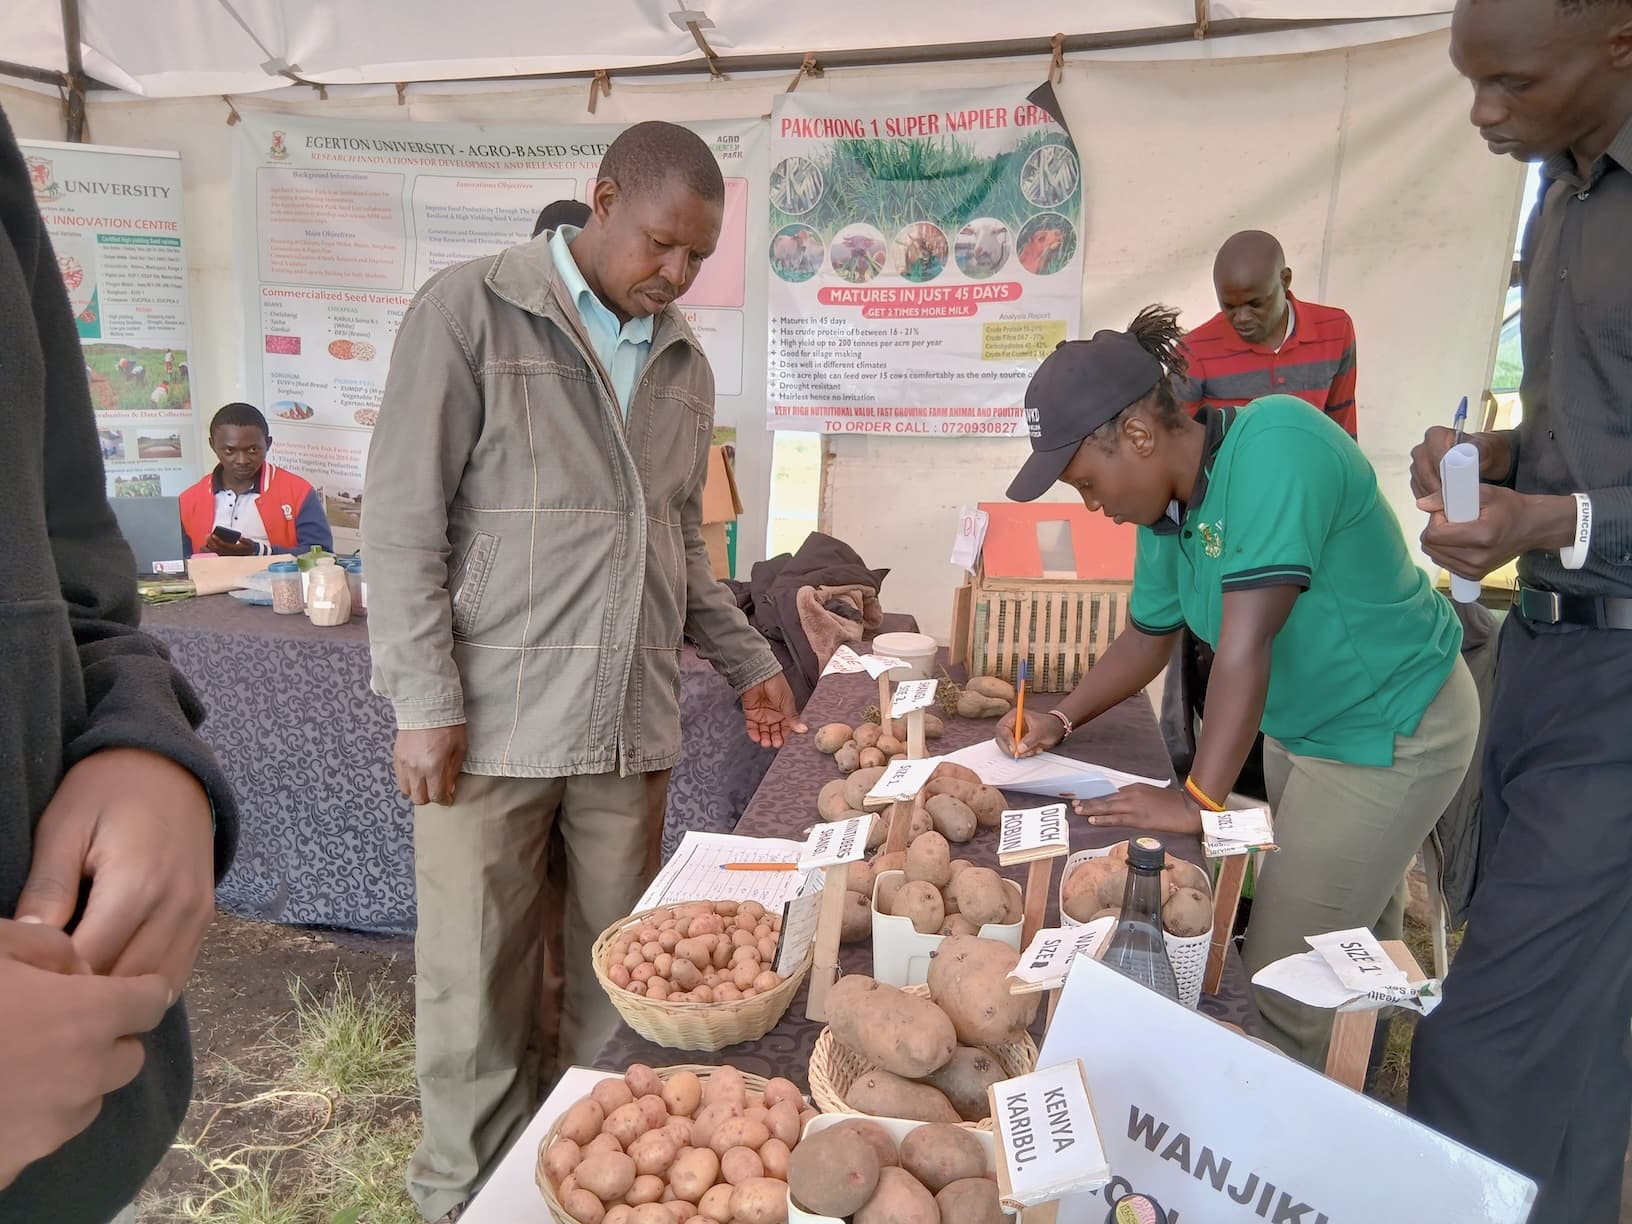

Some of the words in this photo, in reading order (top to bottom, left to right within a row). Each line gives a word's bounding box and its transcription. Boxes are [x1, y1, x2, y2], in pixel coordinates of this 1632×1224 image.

[781, 118, 865, 138] PAKCHONG
[870, 119, 879, 138] 1
[885, 114, 940, 137] SUPER
[945, 107, 1008, 132] NAPIER
[717, 135, 740, 144] AGRO
[305, 136, 371, 151] EGERTON
[373, 139, 455, 156] UNIVERSITY
[468, 144, 567, 158] AGRO-BASED
[311, 152, 355, 162] RESEARCH
[357, 154, 418, 165] INNOVATIONS
[420, 158, 438, 167] FOR
[439, 159, 500, 169] DEVELOPMENT
[504, 161, 523, 169] AND
[526, 161, 562, 169] RELEASE
[565, 161, 576, 169] OF
[722, 151, 743, 160] PARK
[64, 180, 170, 199] UNIVERSITY
[53, 215, 132, 229] INNOVATION
[134, 218, 178, 231] CENTRE
[262, 286, 344, 302] Commercialized
[344, 293, 368, 303] Seed
[830, 288, 897, 303] MATURES
[901, 288, 915, 301] IN
[917, 287, 952, 305] JUST
[955, 287, 970, 300] 45
[972, 285, 1009, 299] DAYS
[868, 308, 885, 317] GET
[894, 307, 919, 317] TIMES
[921, 307, 946, 317] MORE
[948, 306, 970, 316] MILK
[780, 316, 808, 325] Matures
[810, 316, 818, 325] in
[820, 317, 828, 325] 45
[830, 316, 846, 327] days
[780, 328, 794, 336] Has
[795, 328, 816, 336] crude
[817, 328, 845, 338] protein
[846, 328, 854, 336] of
[855, 328, 888, 336] between
[890, 328, 898, 336] 16
[904, 327, 920, 336] 21%
[780, 338, 797, 348] High
[798, 338, 815, 348] yield
[816, 340, 826, 349] up
[828, 339, 837, 347] to
[838, 339, 852, 347] 200
[853, 339, 879, 347] tonnes
[880, 340, 892, 349] per
[911, 340, 924, 349] per
[926, 339, 944, 349] year
[780, 349, 800, 358] Good
[800, 349, 811, 358] for
[813, 349, 833, 359] silage
[834, 350, 862, 360] making
[779, 360, 798, 369] Does
[799, 360, 813, 369] well
[814, 361, 822, 369] in
[823, 360, 855, 369] different
[856, 361, 887, 369] climates
[779, 371, 796, 379] One
[844, 371, 860, 380] feed
[879, 372, 888, 380] 15
[909, 371, 955, 381] comfortably
[966, 371, 979, 379] the
[980, 371, 998, 381] only
[779, 381, 810, 391] Drought
[810, 382, 841, 391] resistant
[810, 392, 831, 401] hence
[842, 392, 876, 401] irritation
[774, 406, 791, 416] VERY
[810, 406, 853, 417] NUTRITIONAL
[876, 407, 893, 417] FAST
[894, 407, 928, 417] GROWING
[928, 408, 948, 417] FARM
[949, 408, 976, 417] ANIMAL
[976, 408, 993, 417] AND
[993, 408, 1024, 417] POULTRY
[825, 421, 842, 432] TO
[845, 421, 891, 432] ORDER
[895, 422, 930, 433] CALL
[942, 422, 1017, 434] 0720930827
[1039, 807, 1060, 842] DUTCH
[1034, 938, 1062, 964] SIZE
[1340, 940, 1375, 968] SIZE
[1358, 964, 1383, 975] 1
[1043, 1086, 1076, 1154] KENYA
[1127, 1104, 1331, 1224] WANJIK
